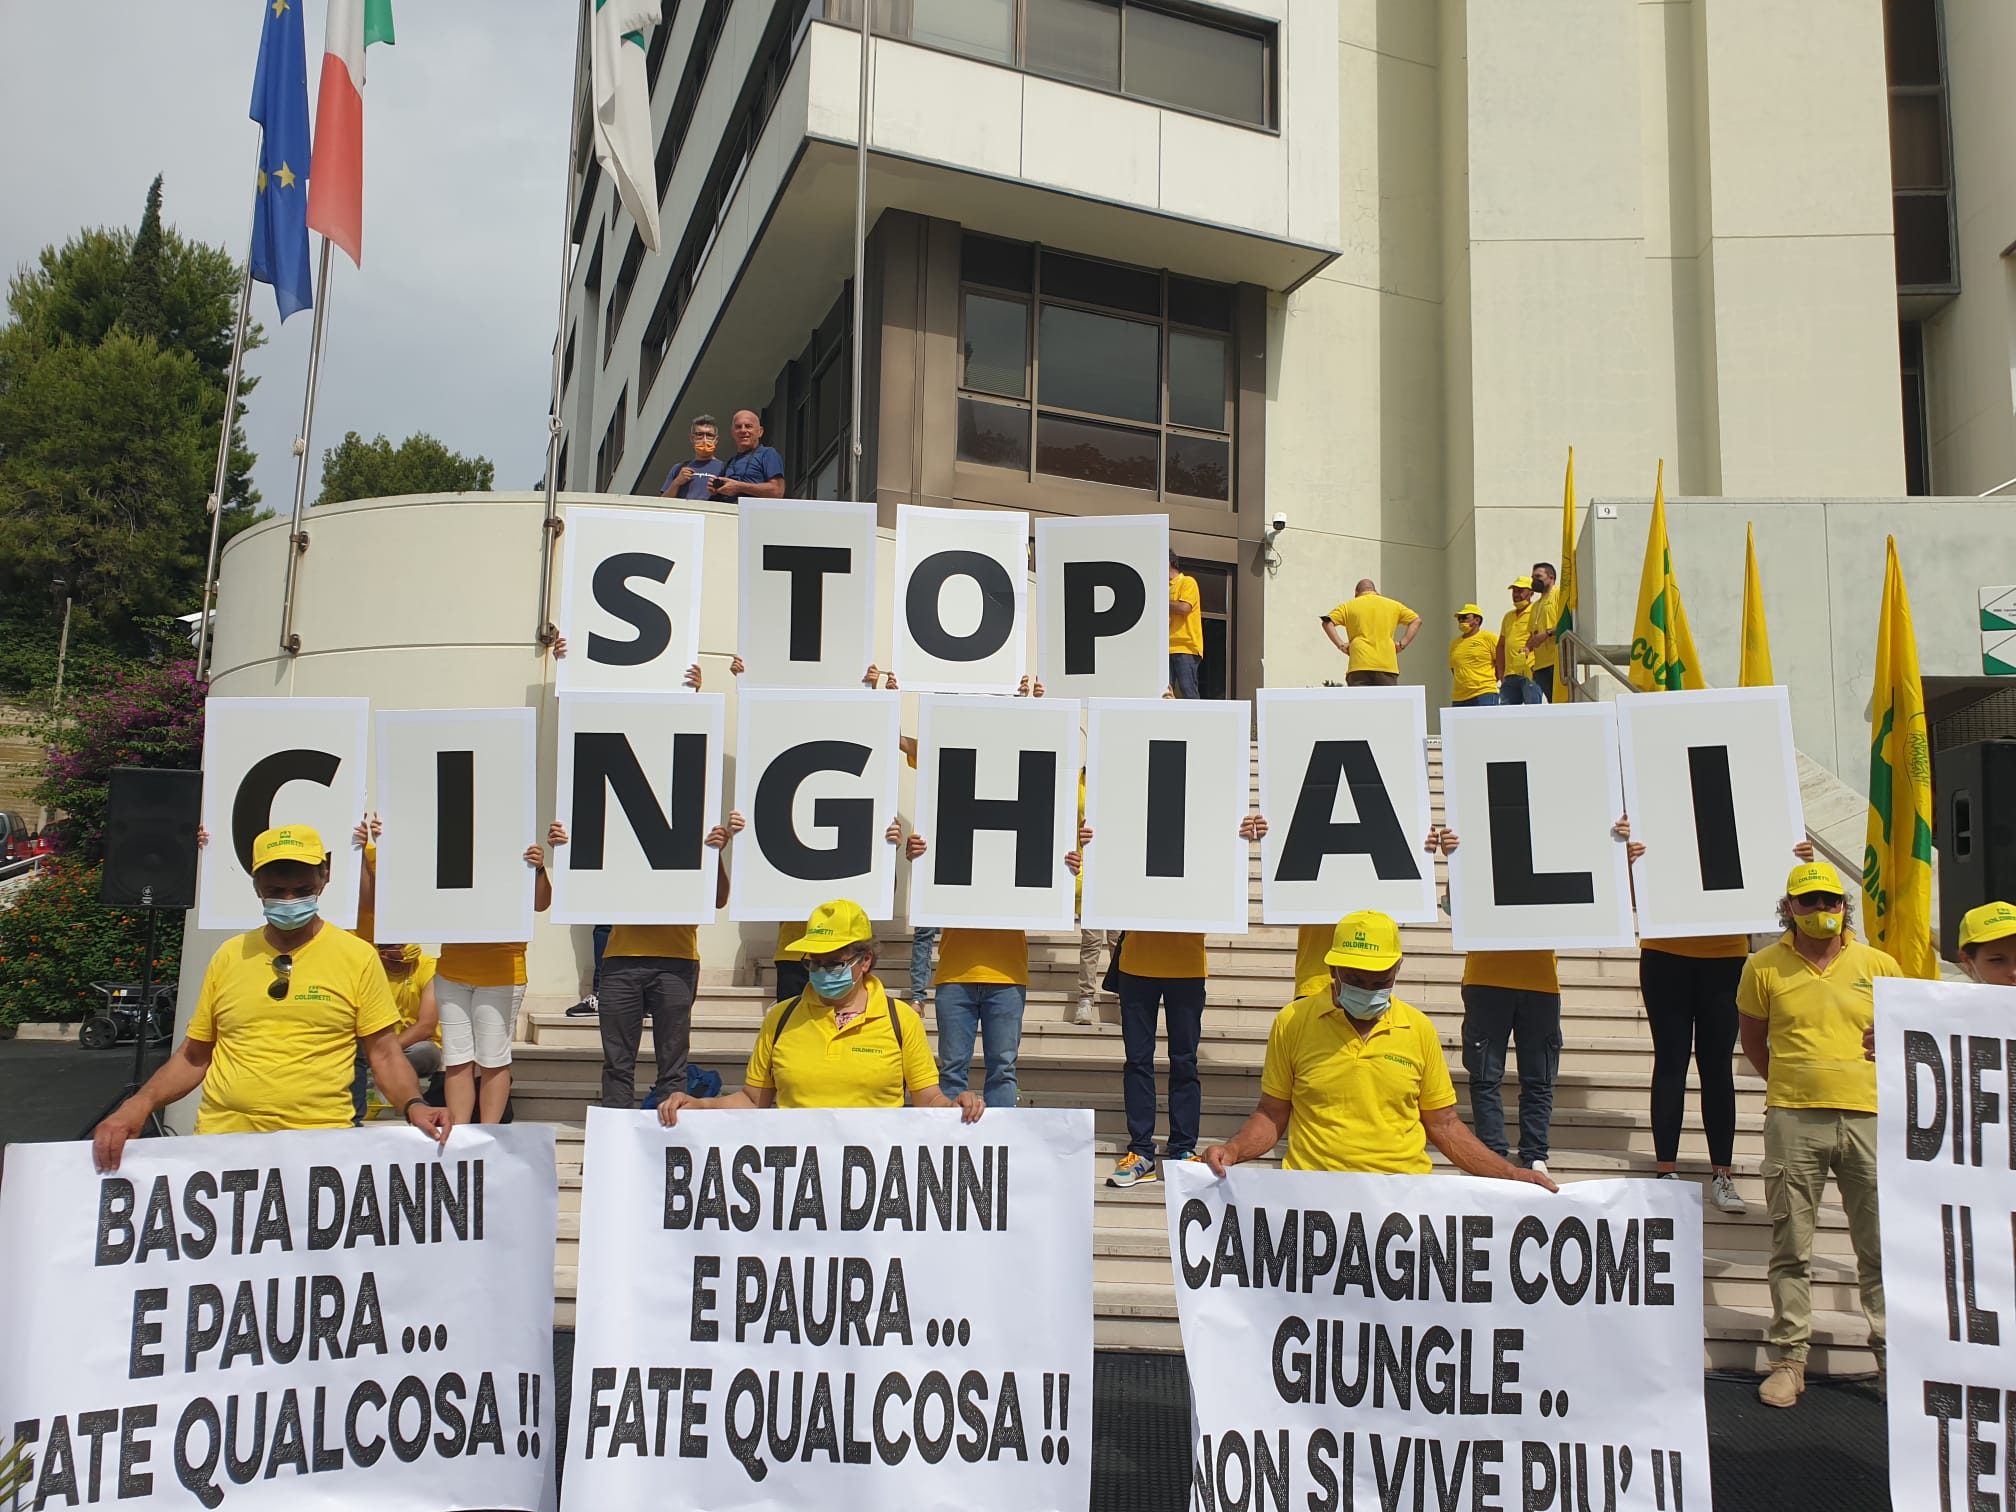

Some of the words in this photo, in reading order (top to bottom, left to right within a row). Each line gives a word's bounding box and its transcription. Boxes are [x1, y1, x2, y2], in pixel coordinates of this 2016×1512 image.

[1604, 507, 1611, 515] 9
[587, 544, 1146, 675] STOP
[231, 732, 1744, 906] CINGHIALI
[1342, 941, 1379, 951] COLDIRETTI
[1903, 1029, 2016, 1171] DIF
[94, 1167, 294, 1267] BASTA
[306, 1159, 484, 1251] DANNI
[664, 1145, 828, 1232] BASTA
[839, 1145, 1009, 1232] DANNI
[690, 1255, 721, 1342] E
[735, 1256, 913, 1347] PAURA
[1179, 1198, 1494, 1304] CAMPAGNE
[1509, 1215, 1675, 1306] COME
[1941, 1204, 2000, 1346] IL
[128, 1287, 168, 1379] E
[185, 1271, 388, 1373] PAURA
[1271, 1315, 1524, 1416] GIUNGLE
[173, 1371, 506, 1509] QUALCOSA
[585, 1367, 713, 1460] FATE
[724, 1368, 1029, 1482] QUALCOSA
[1307, 1428, 1355, 1512] SI
[1369, 1433, 1504, 1512] VIVE
[1923, 1380, 2016, 1512] TE
